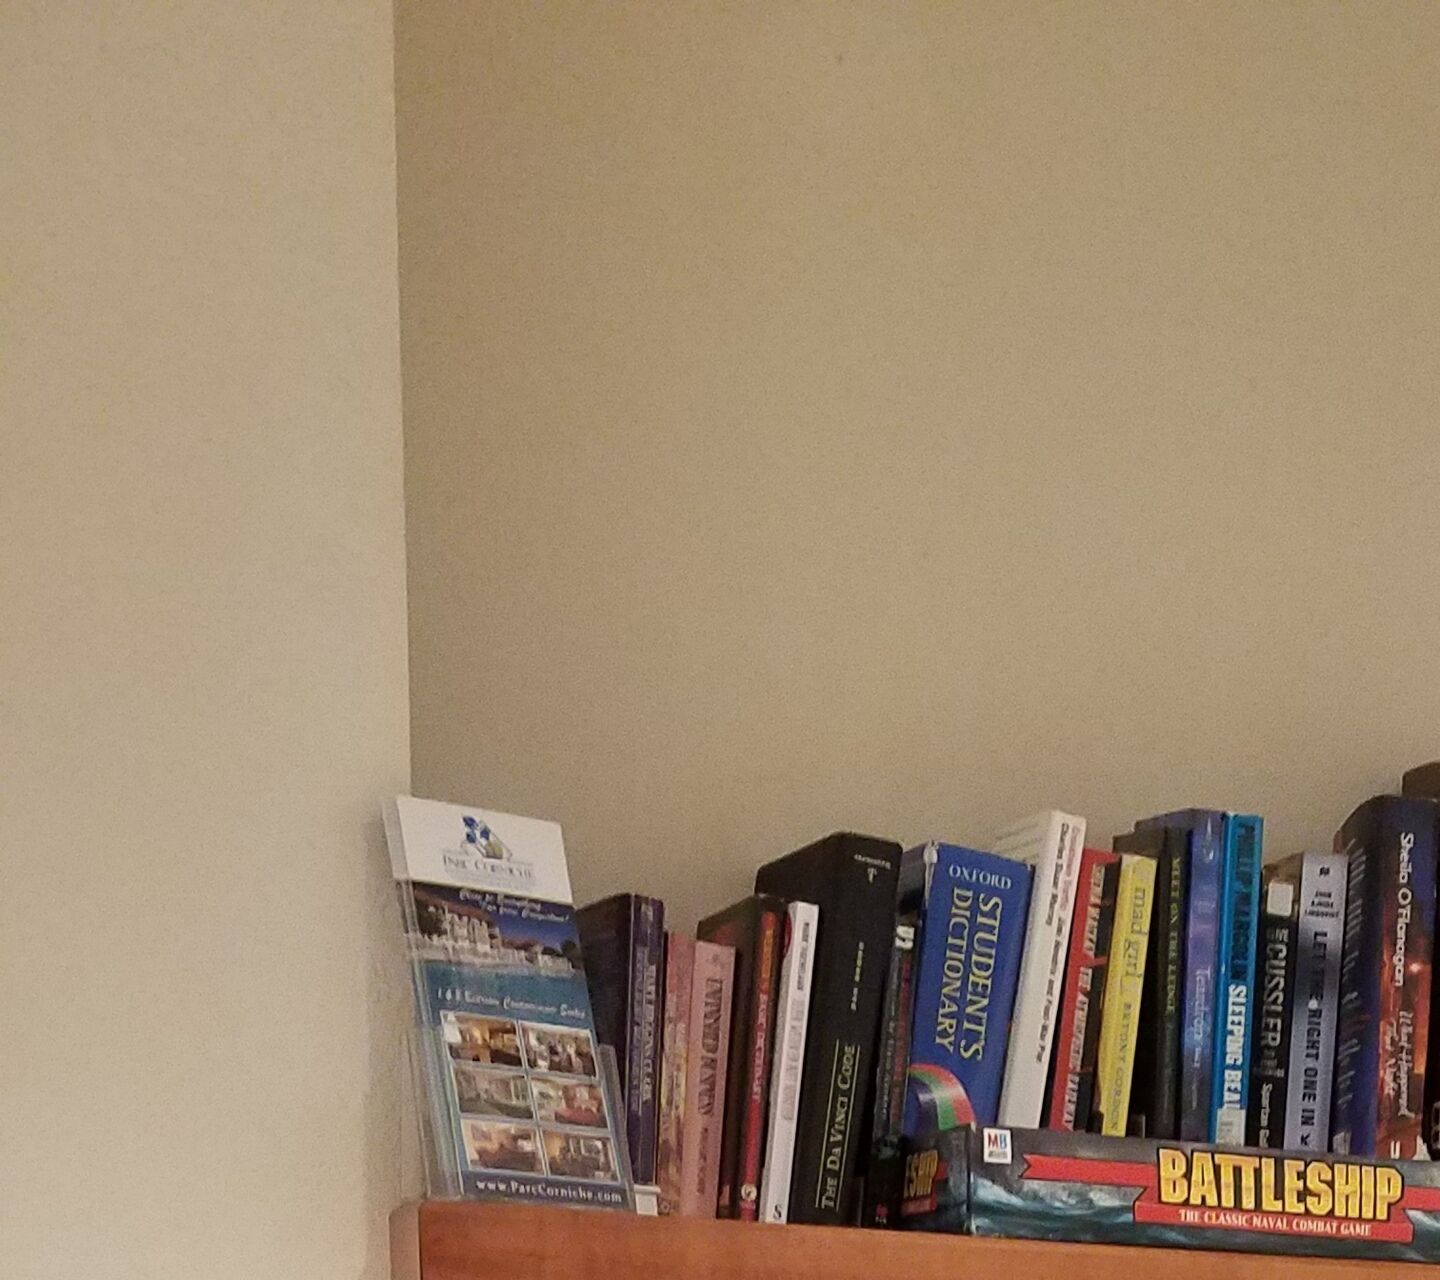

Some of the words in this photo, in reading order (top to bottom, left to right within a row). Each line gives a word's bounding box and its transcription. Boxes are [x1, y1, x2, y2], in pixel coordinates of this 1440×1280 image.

[948, 865, 1012, 890] OXFORD
[1399, 832, 1415, 883] Sheila
[1130, 886, 1151, 936] mad
[1122, 938, 1144, 979] girl
[1312, 930, 1328, 960] LET
[1394, 887, 1413, 988] O'Flanagan
[933, 886, 973, 1053] DICTIONARY
[961, 894, 1003, 1060] STUDENT'S
[1260, 942, 1290, 1047] CUSSLER
[1225, 984, 1247, 1065] SLEEPING
[1305, 1009, 1322, 1060] RIGHT
[836, 1045, 854, 1090] CODE
[1302, 1066, 1318, 1102] ONE
[830, 1097, 847, 1142] VINCI
[1109, 1066, 1127, 1132] GORDON
[1300, 1107, 1315, 1127] IN
[821, 1177, 836, 1209] THE
[1158, 1147, 1403, 1221] BATTLESHIP
[1178, 1209, 1202, 1224] THE
[1203, 1210, 1249, 1227] CLASSIC
[1252, 1214, 1289, 1231] NAVAL
[1291, 1217, 1338, 1234] COMBAT
[1340, 1221, 1372, 1237] GAME
